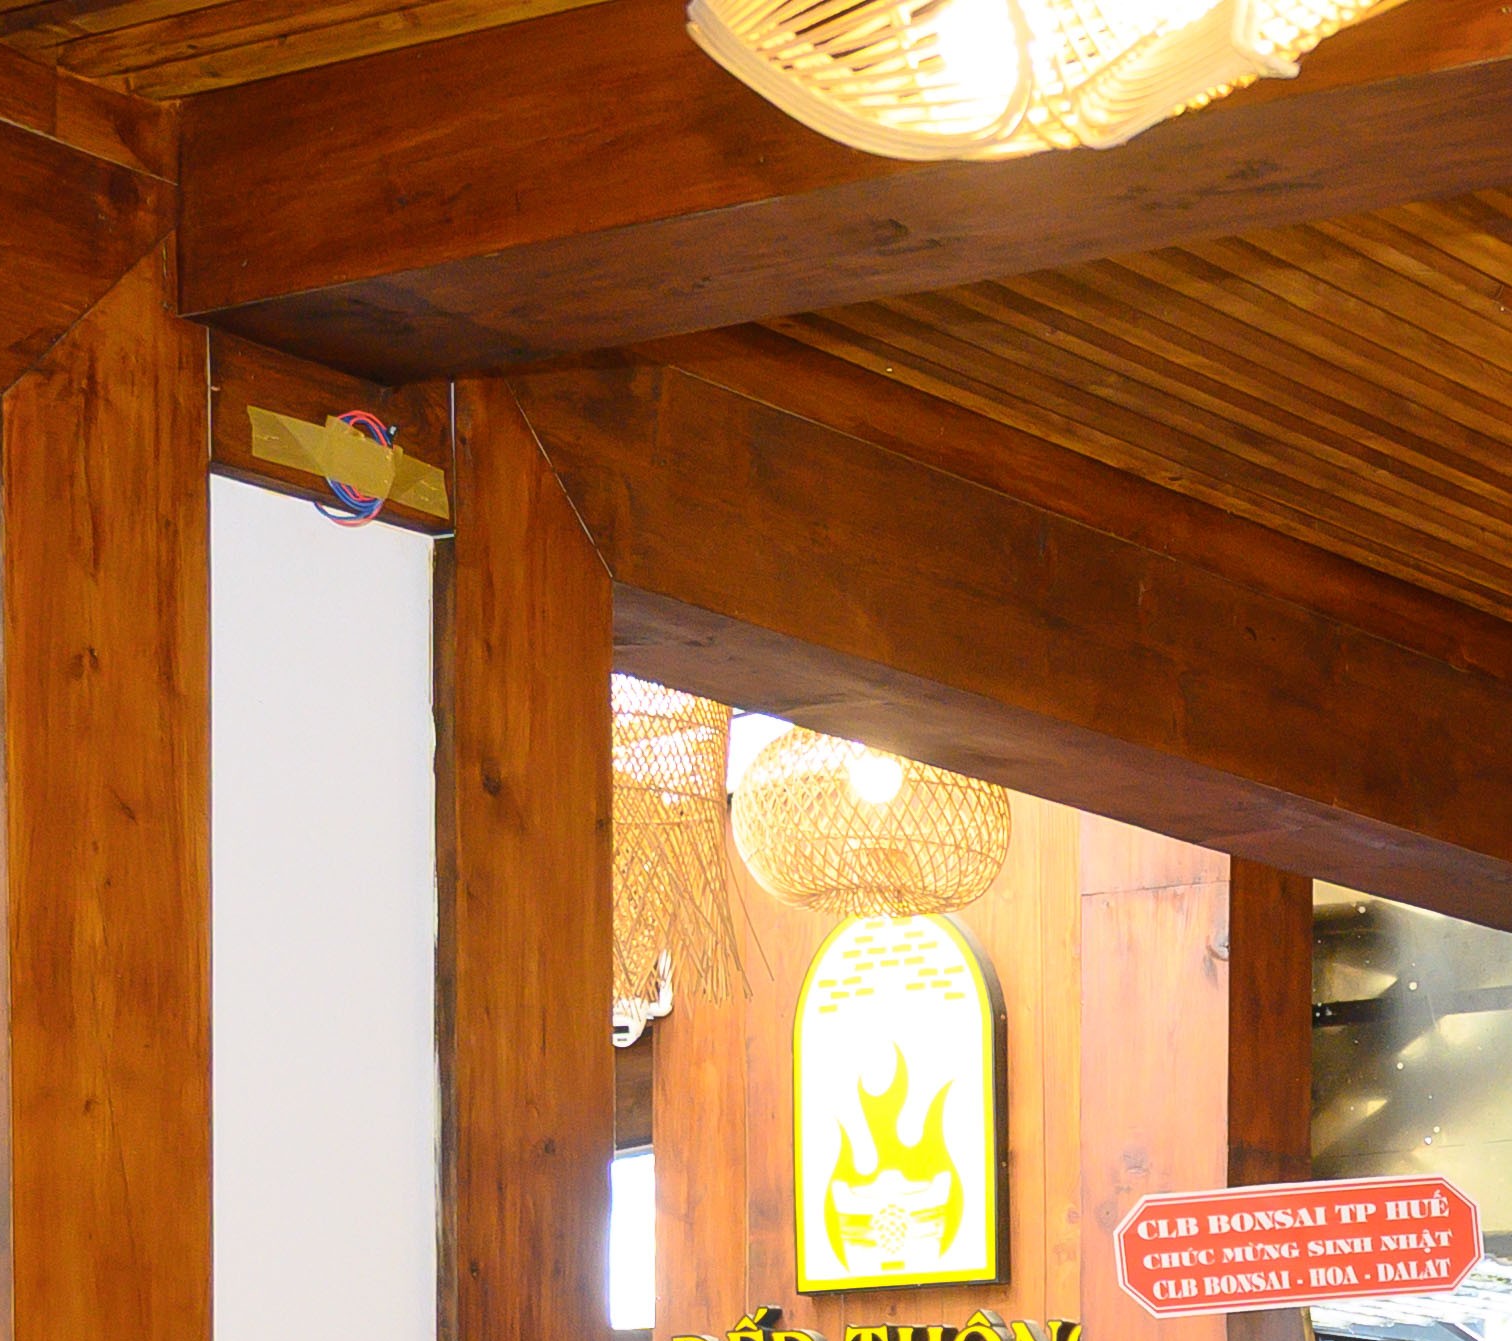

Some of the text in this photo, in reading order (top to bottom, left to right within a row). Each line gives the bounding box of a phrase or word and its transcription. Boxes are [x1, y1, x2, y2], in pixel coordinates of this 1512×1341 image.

[1136, 1189, 1450, 1241] CLB BONSAI TP HUẾ
[1142, 1229, 1453, 1271] CHÚC MỪNG SINH NHẬT
[1152, 1276, 1198, 1302] CLB
[1204, 1270, 1291, 1297] BONSAI
[1310, 1264, 1359, 1288] HOA
[1377, 1258, 1451, 1284] DALAT
